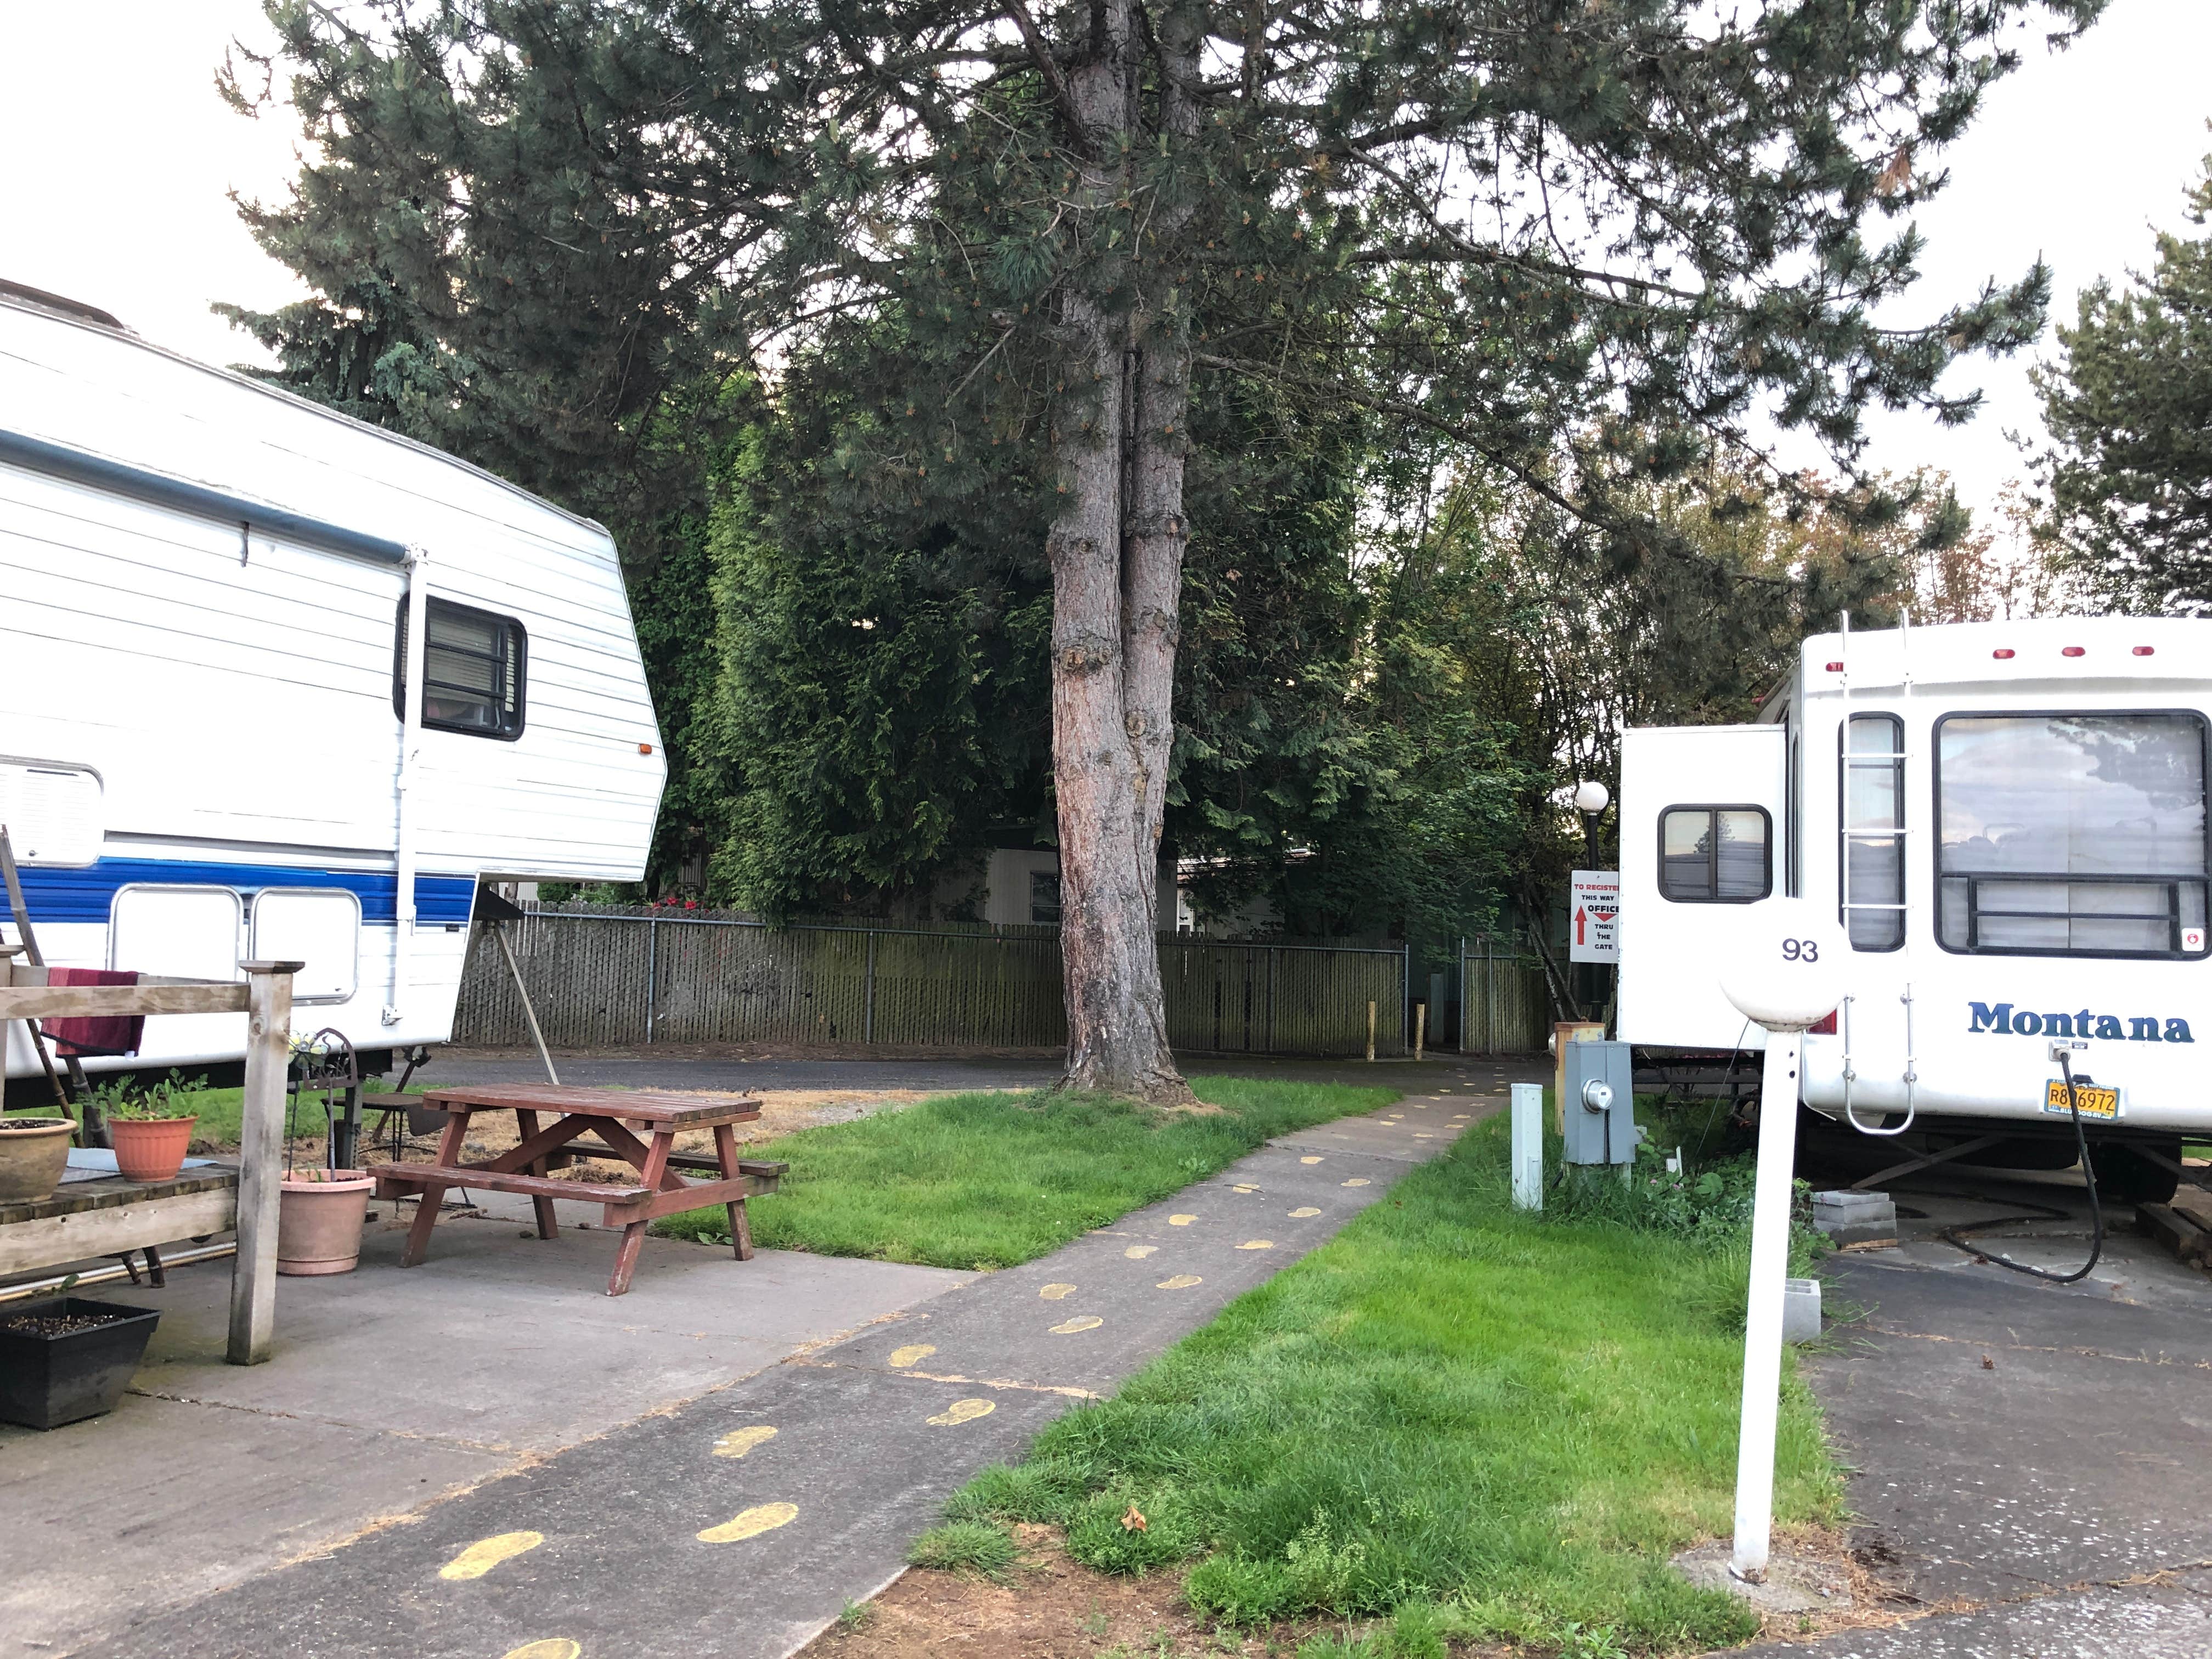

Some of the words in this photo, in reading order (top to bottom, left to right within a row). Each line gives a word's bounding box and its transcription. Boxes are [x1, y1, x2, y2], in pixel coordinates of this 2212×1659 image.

[1782, 938, 1819, 962] 93
[1968, 1001, 2195, 1043] Montana
[2050, 1089, 2114, 1111] R86972
